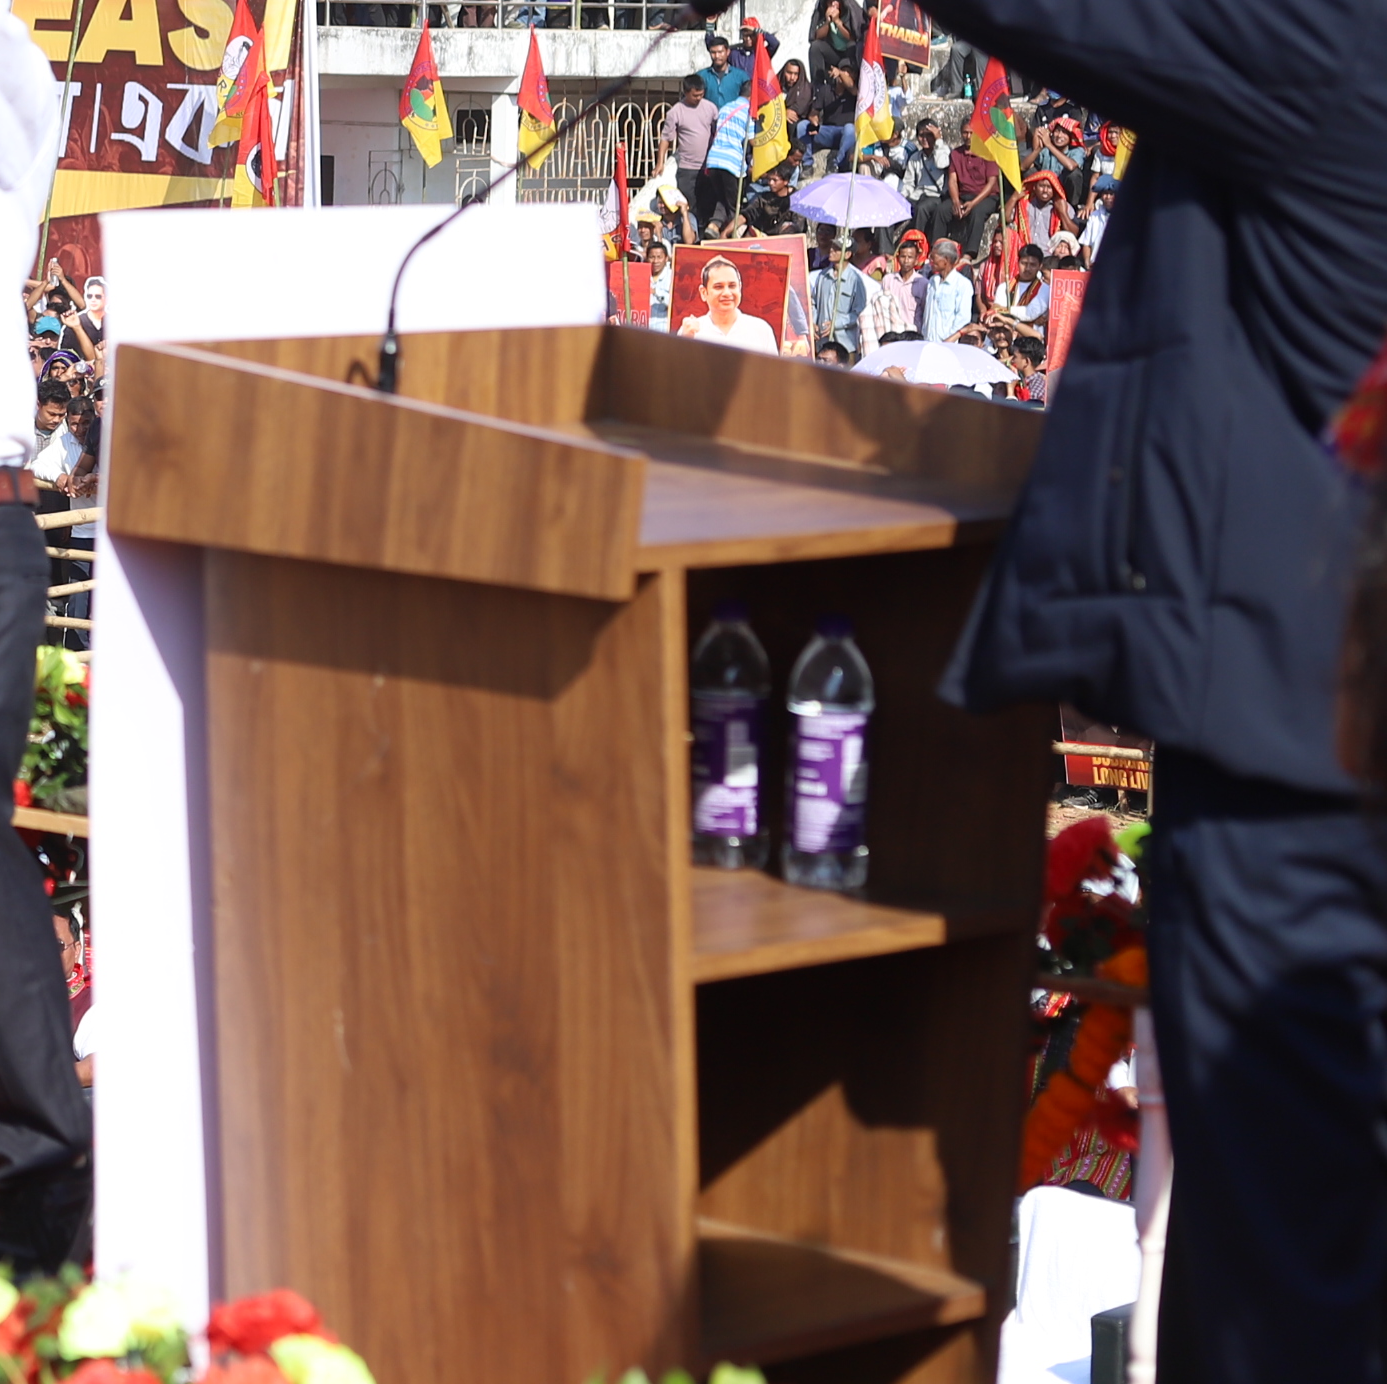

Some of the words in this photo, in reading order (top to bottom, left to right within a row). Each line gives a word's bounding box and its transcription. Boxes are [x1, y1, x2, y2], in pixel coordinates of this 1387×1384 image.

[880, 23, 928, 48] THANSA
[1093, 767, 1128, 787] LONG
[1130, 771, 1149, 790] LIV
